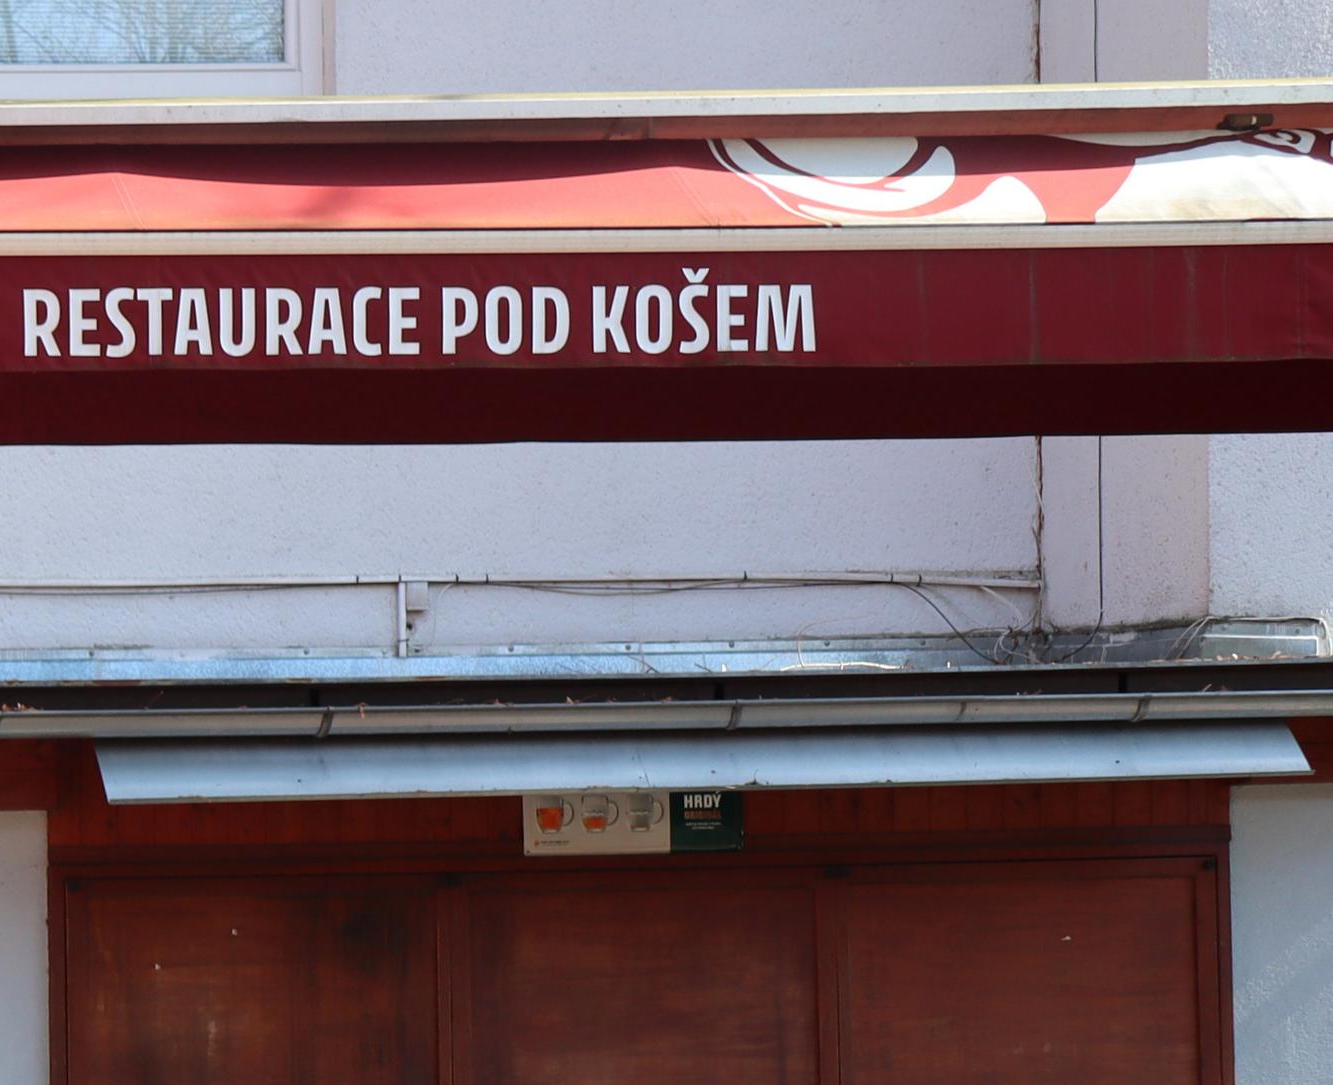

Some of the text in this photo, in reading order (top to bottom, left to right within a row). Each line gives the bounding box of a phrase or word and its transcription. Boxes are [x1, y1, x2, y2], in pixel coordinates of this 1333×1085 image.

[22, 267, 817, 357] RESTAURACE POD KOŠEM
[683, 791, 722, 809] HRDÝ
